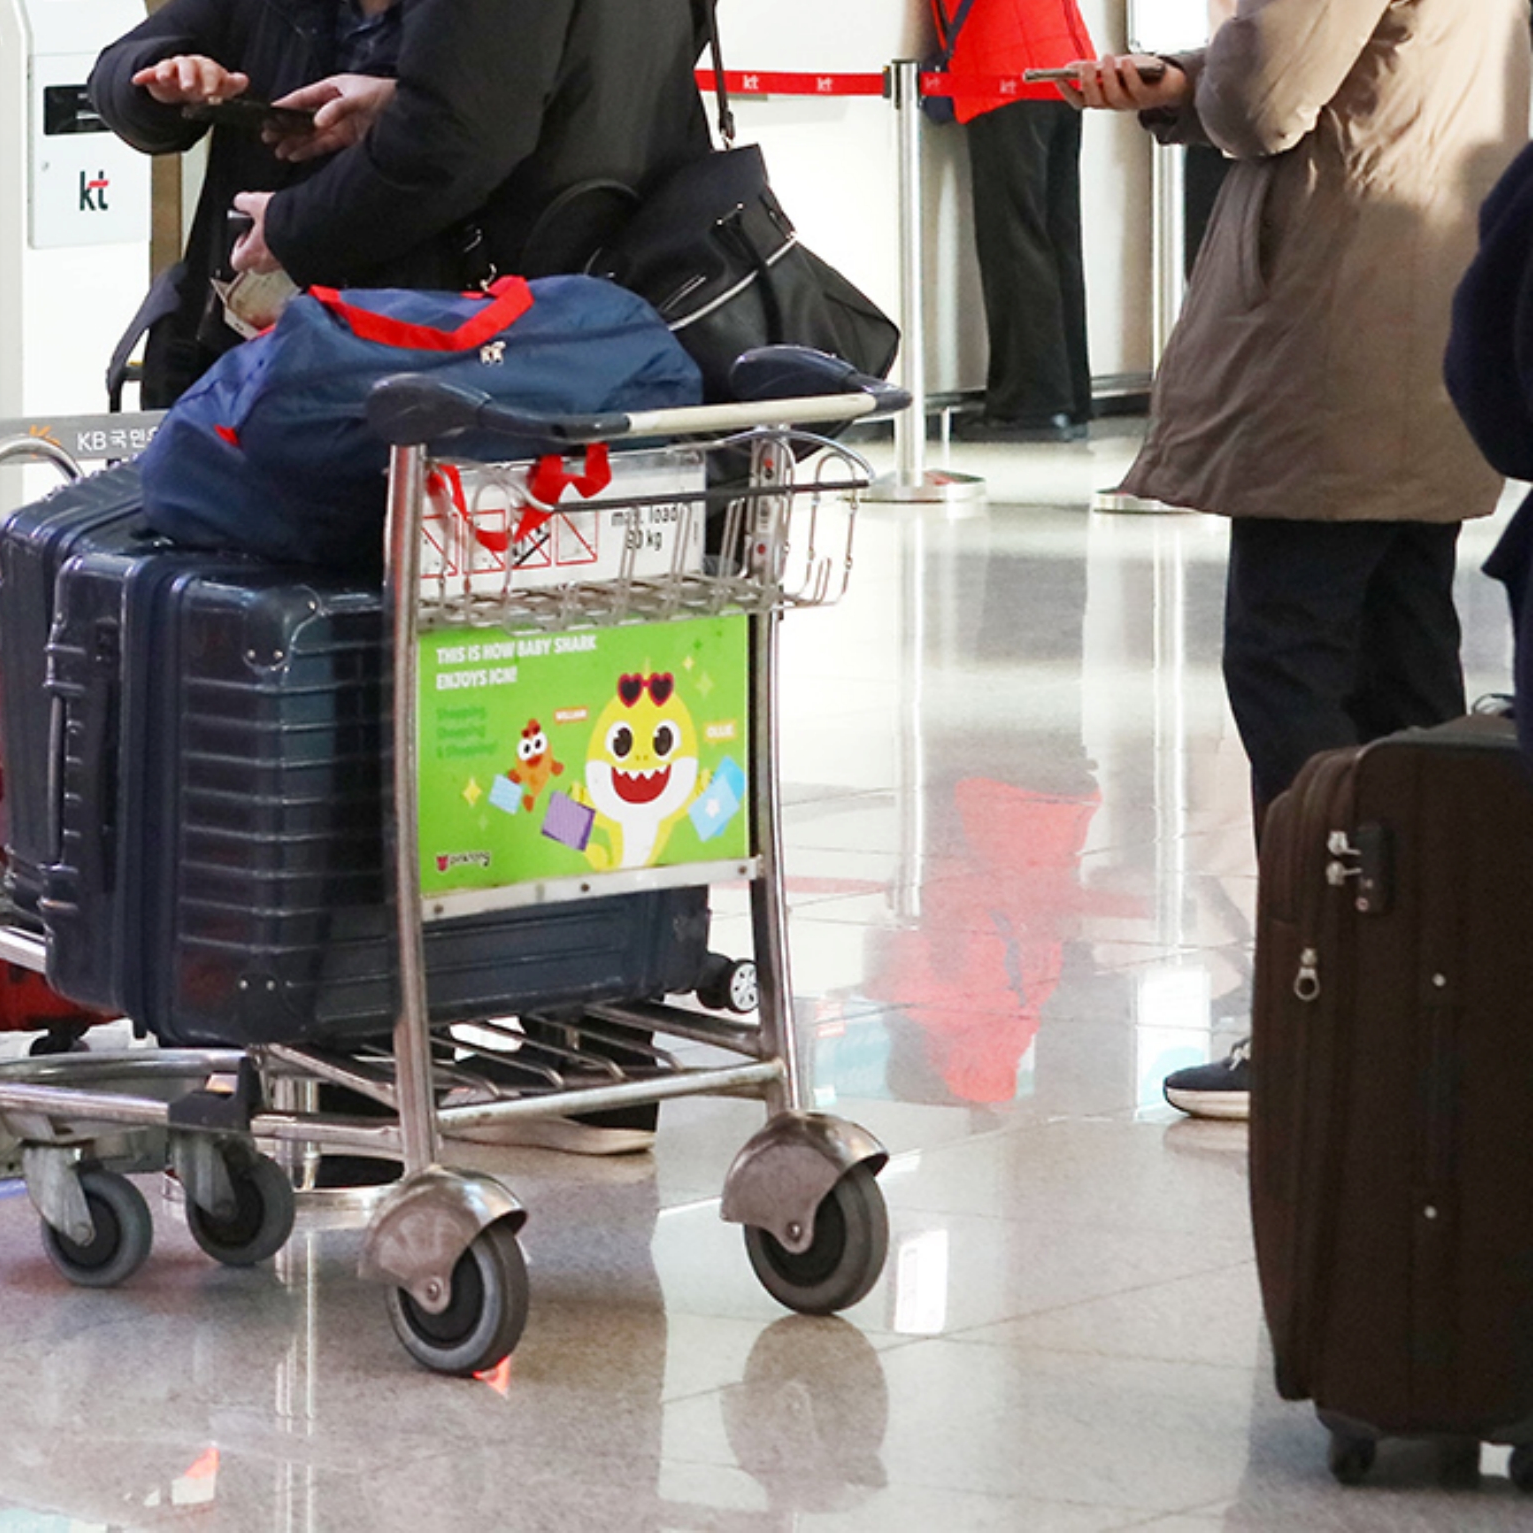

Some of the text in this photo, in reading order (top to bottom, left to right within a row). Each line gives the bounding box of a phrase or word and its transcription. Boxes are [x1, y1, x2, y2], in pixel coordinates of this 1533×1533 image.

[79, 170, 110, 211] kt
[436, 634, 597, 665] THIS IS HOW BABY SHARK
[436, 669, 488, 691] ENJOYS
[705, 724, 734, 739] OLLIE
